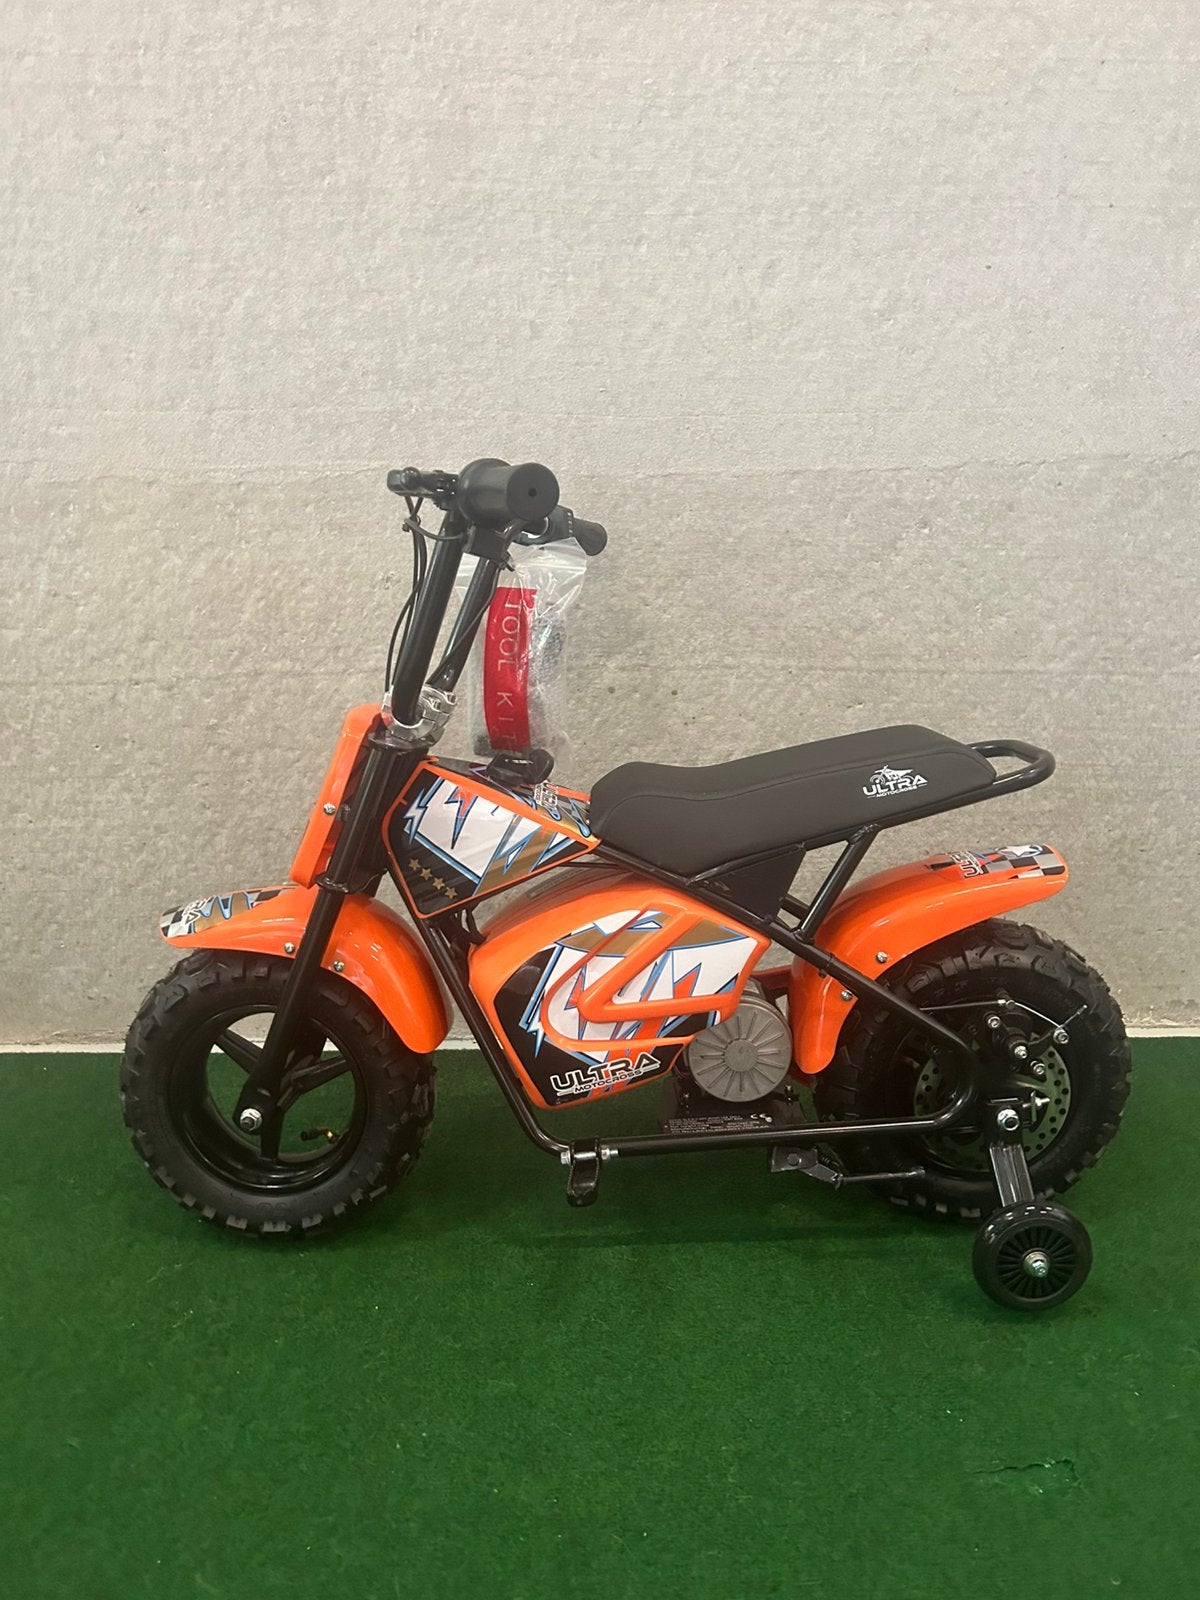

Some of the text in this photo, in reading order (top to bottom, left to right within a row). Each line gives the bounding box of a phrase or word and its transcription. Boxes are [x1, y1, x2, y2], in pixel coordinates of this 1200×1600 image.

[496, 599, 522, 745] TOOL KIT
[862, 774, 928, 796] ULTRA
[876, 785, 918, 798] MOTOCROSS
[550, 1052, 661, 1093] ULTRA
[574, 1069, 643, 1094] MOTOCROSS
